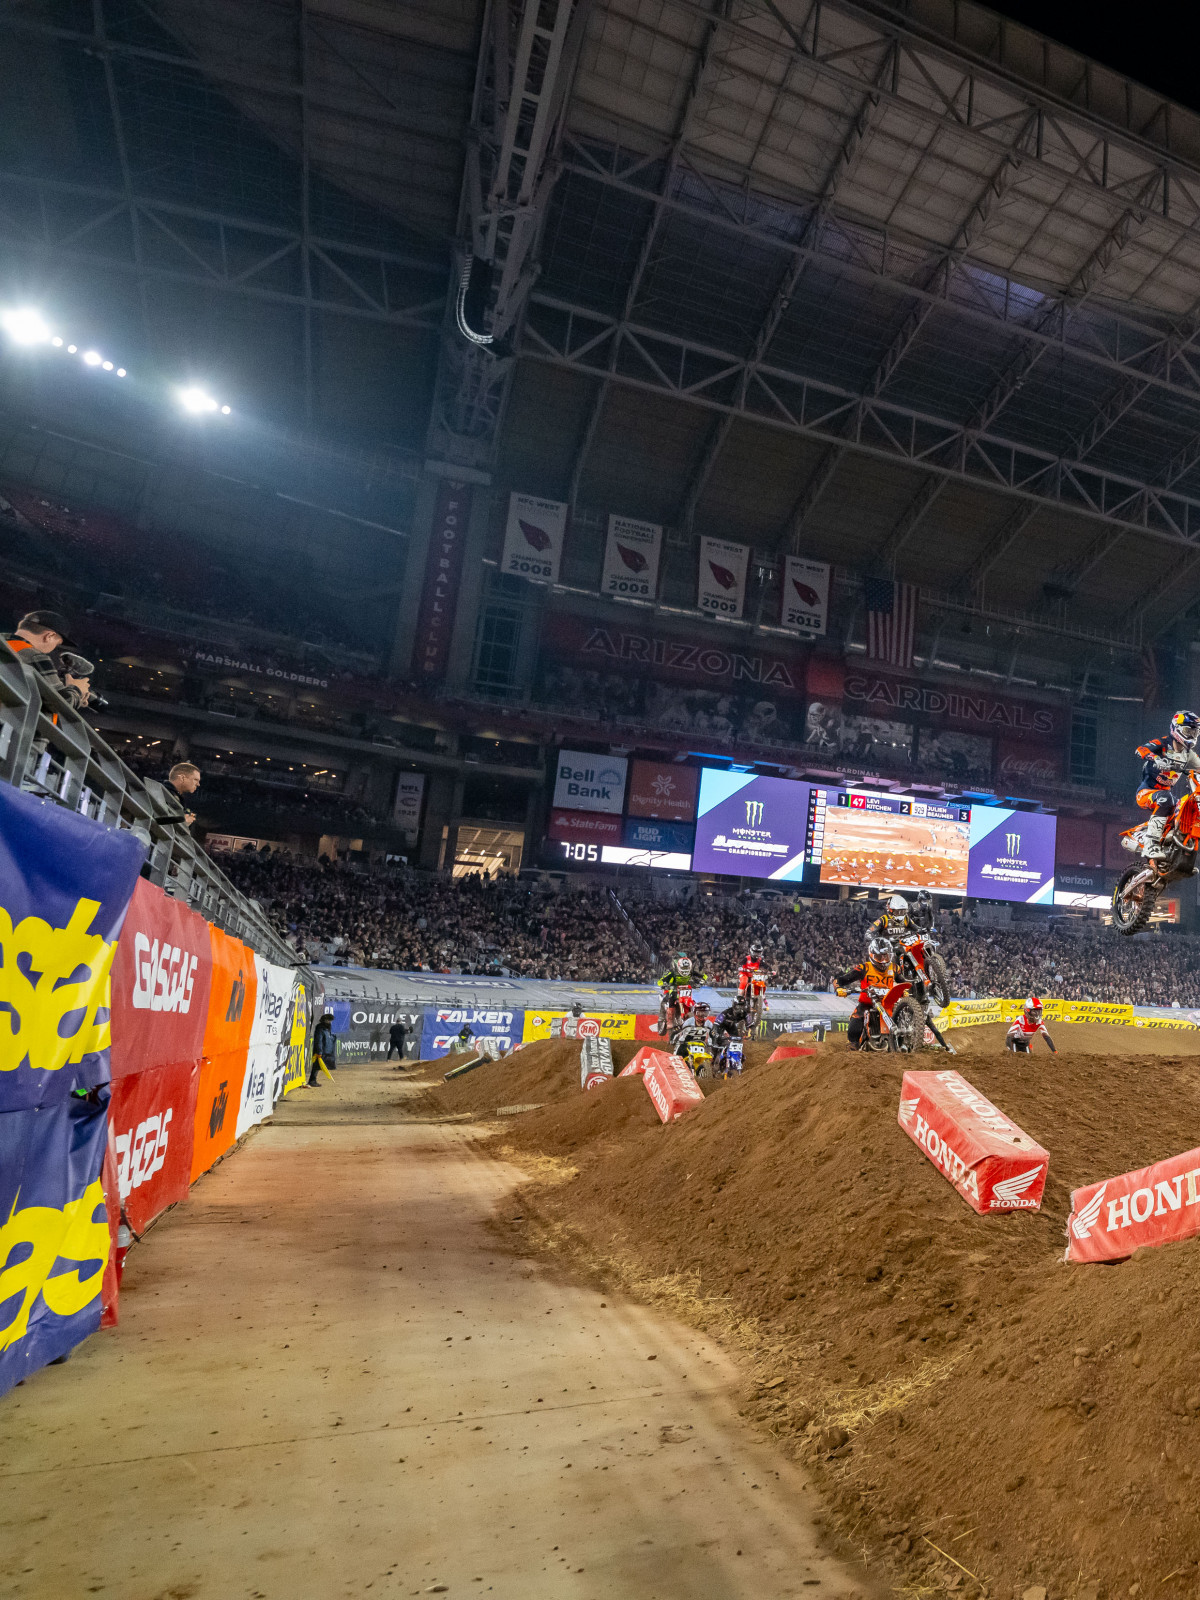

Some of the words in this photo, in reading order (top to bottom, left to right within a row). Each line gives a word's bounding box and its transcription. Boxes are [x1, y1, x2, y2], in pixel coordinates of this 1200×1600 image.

[510, 560, 552, 577] 2008
[609, 580, 649, 595] 2008
[702, 597, 737, 613] 2009
[787, 613, 821, 629] 2015
[580, 628, 795, 688] ARIZONA
[195, 651, 263, 673] MARSHALL
[266, 667, 329, 688] GOLDBERG
[843, 677, 1054, 733] CARDINALS
[560, 766, 594, 783] Bell
[836, 766, 881, 778] CARDINALS
[567, 783, 611, 800] Bank
[632, 794, 663, 807] Dignity
[664, 797, 691, 808] Health
[852, 796, 864, 807] 47
[866, 798, 880, 806] LEVI
[866, 803, 892, 812] KITCHEN
[902, 804, 909, 813] 2
[914, 806, 926, 816] 929
[927, 806, 947, 814] JULIEN
[927, 811, 954, 820] BEAUMER
[961, 811, 968, 821] 3
[638, 826, 659, 836] BUD
[732, 828, 772, 839] MONSTER
[633, 833, 663, 843] LIGHT
[560, 842, 598, 862] 7:05
[728, 848, 772, 858] CHAMPIONSHIP
[996, 857, 1028, 866] MONSTER
[1060, 875, 1094, 886] verizon
[133, 932, 198, 1013] GASGAS
[867, 976, 893, 985] FXR
[963, 1002, 998, 1011] DUNLOP
[1080, 1005, 1127, 1014] DUNLOP
[436, 1009, 514, 1024] FALKEN
[959, 1014, 1001, 1024] DUNLOP
[1074, 1016, 1130, 1025] DUNLOP
[491, 1025, 510, 1033] TIRES
[341, 1041, 371, 1051] MONSTER
[649, 1078, 669, 1120] HONDA
[913, 1113, 980, 1201] HONDA
[990, 1199, 1037, 1208] HONDA
